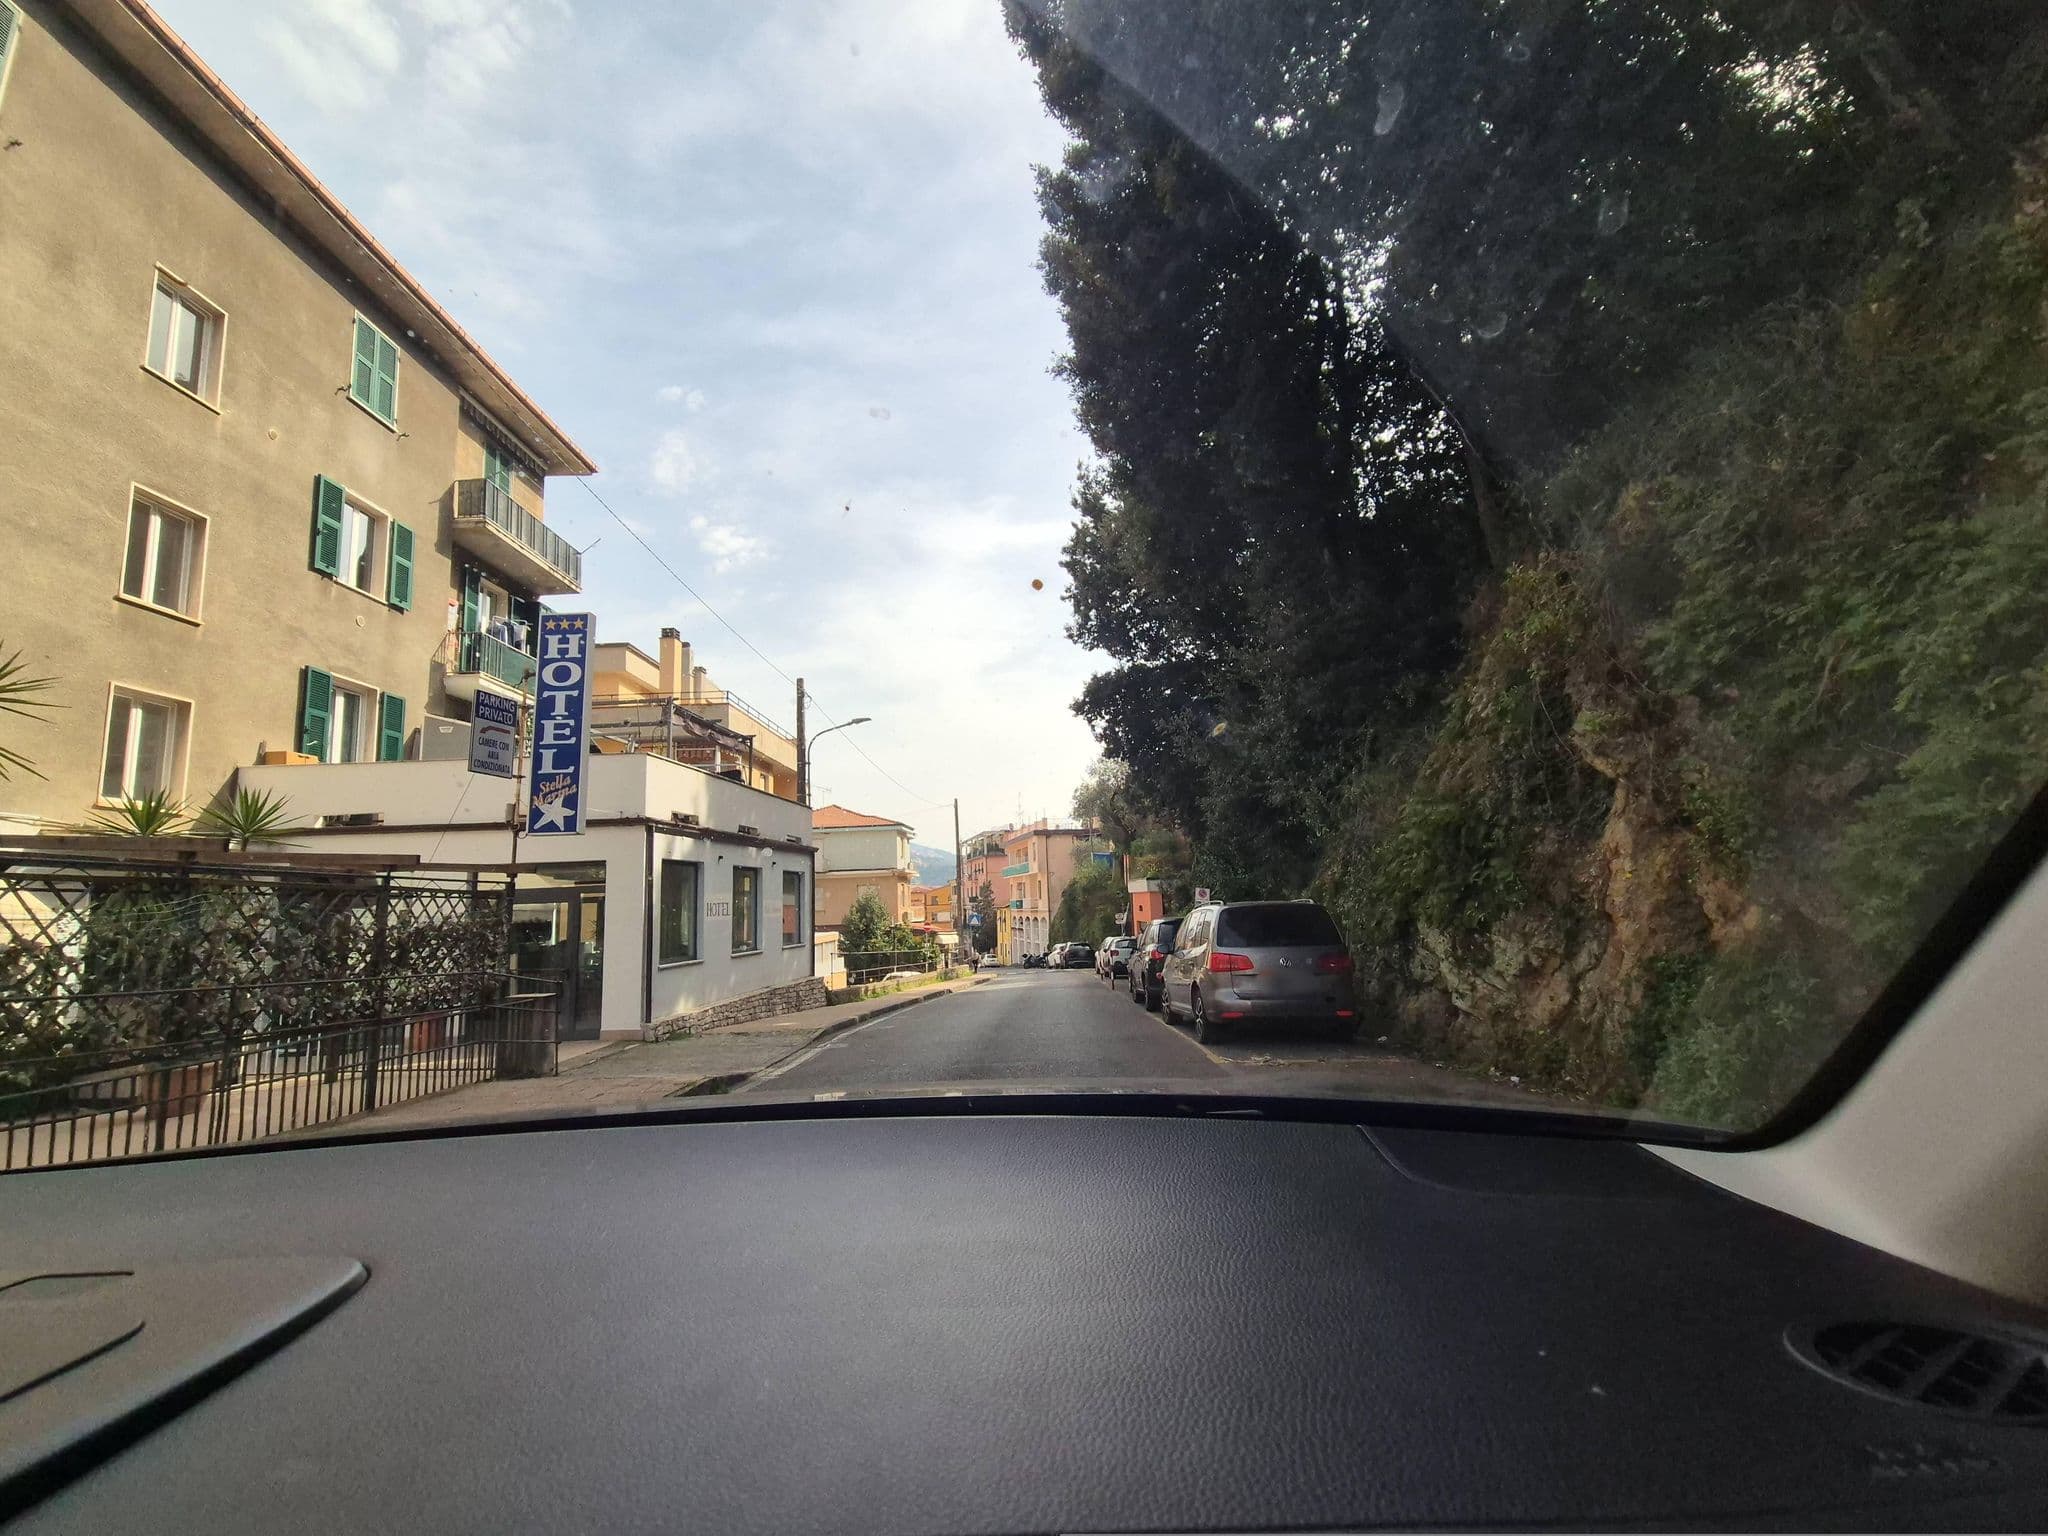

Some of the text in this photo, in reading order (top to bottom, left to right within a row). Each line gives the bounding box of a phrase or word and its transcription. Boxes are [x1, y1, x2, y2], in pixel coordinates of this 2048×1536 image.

[479, 692, 515, 712] PARKING
[538, 634, 584, 775] HOTEL
[478, 705, 513, 724] PRIVATO
[478, 737, 510, 751] CAMERE CON
[473, 758, 510, 774] CONDIZIONATA
[539, 774, 571, 794] Stella
[532, 783, 577, 807] Marina
[706, 902, 731, 917] HOTEL
